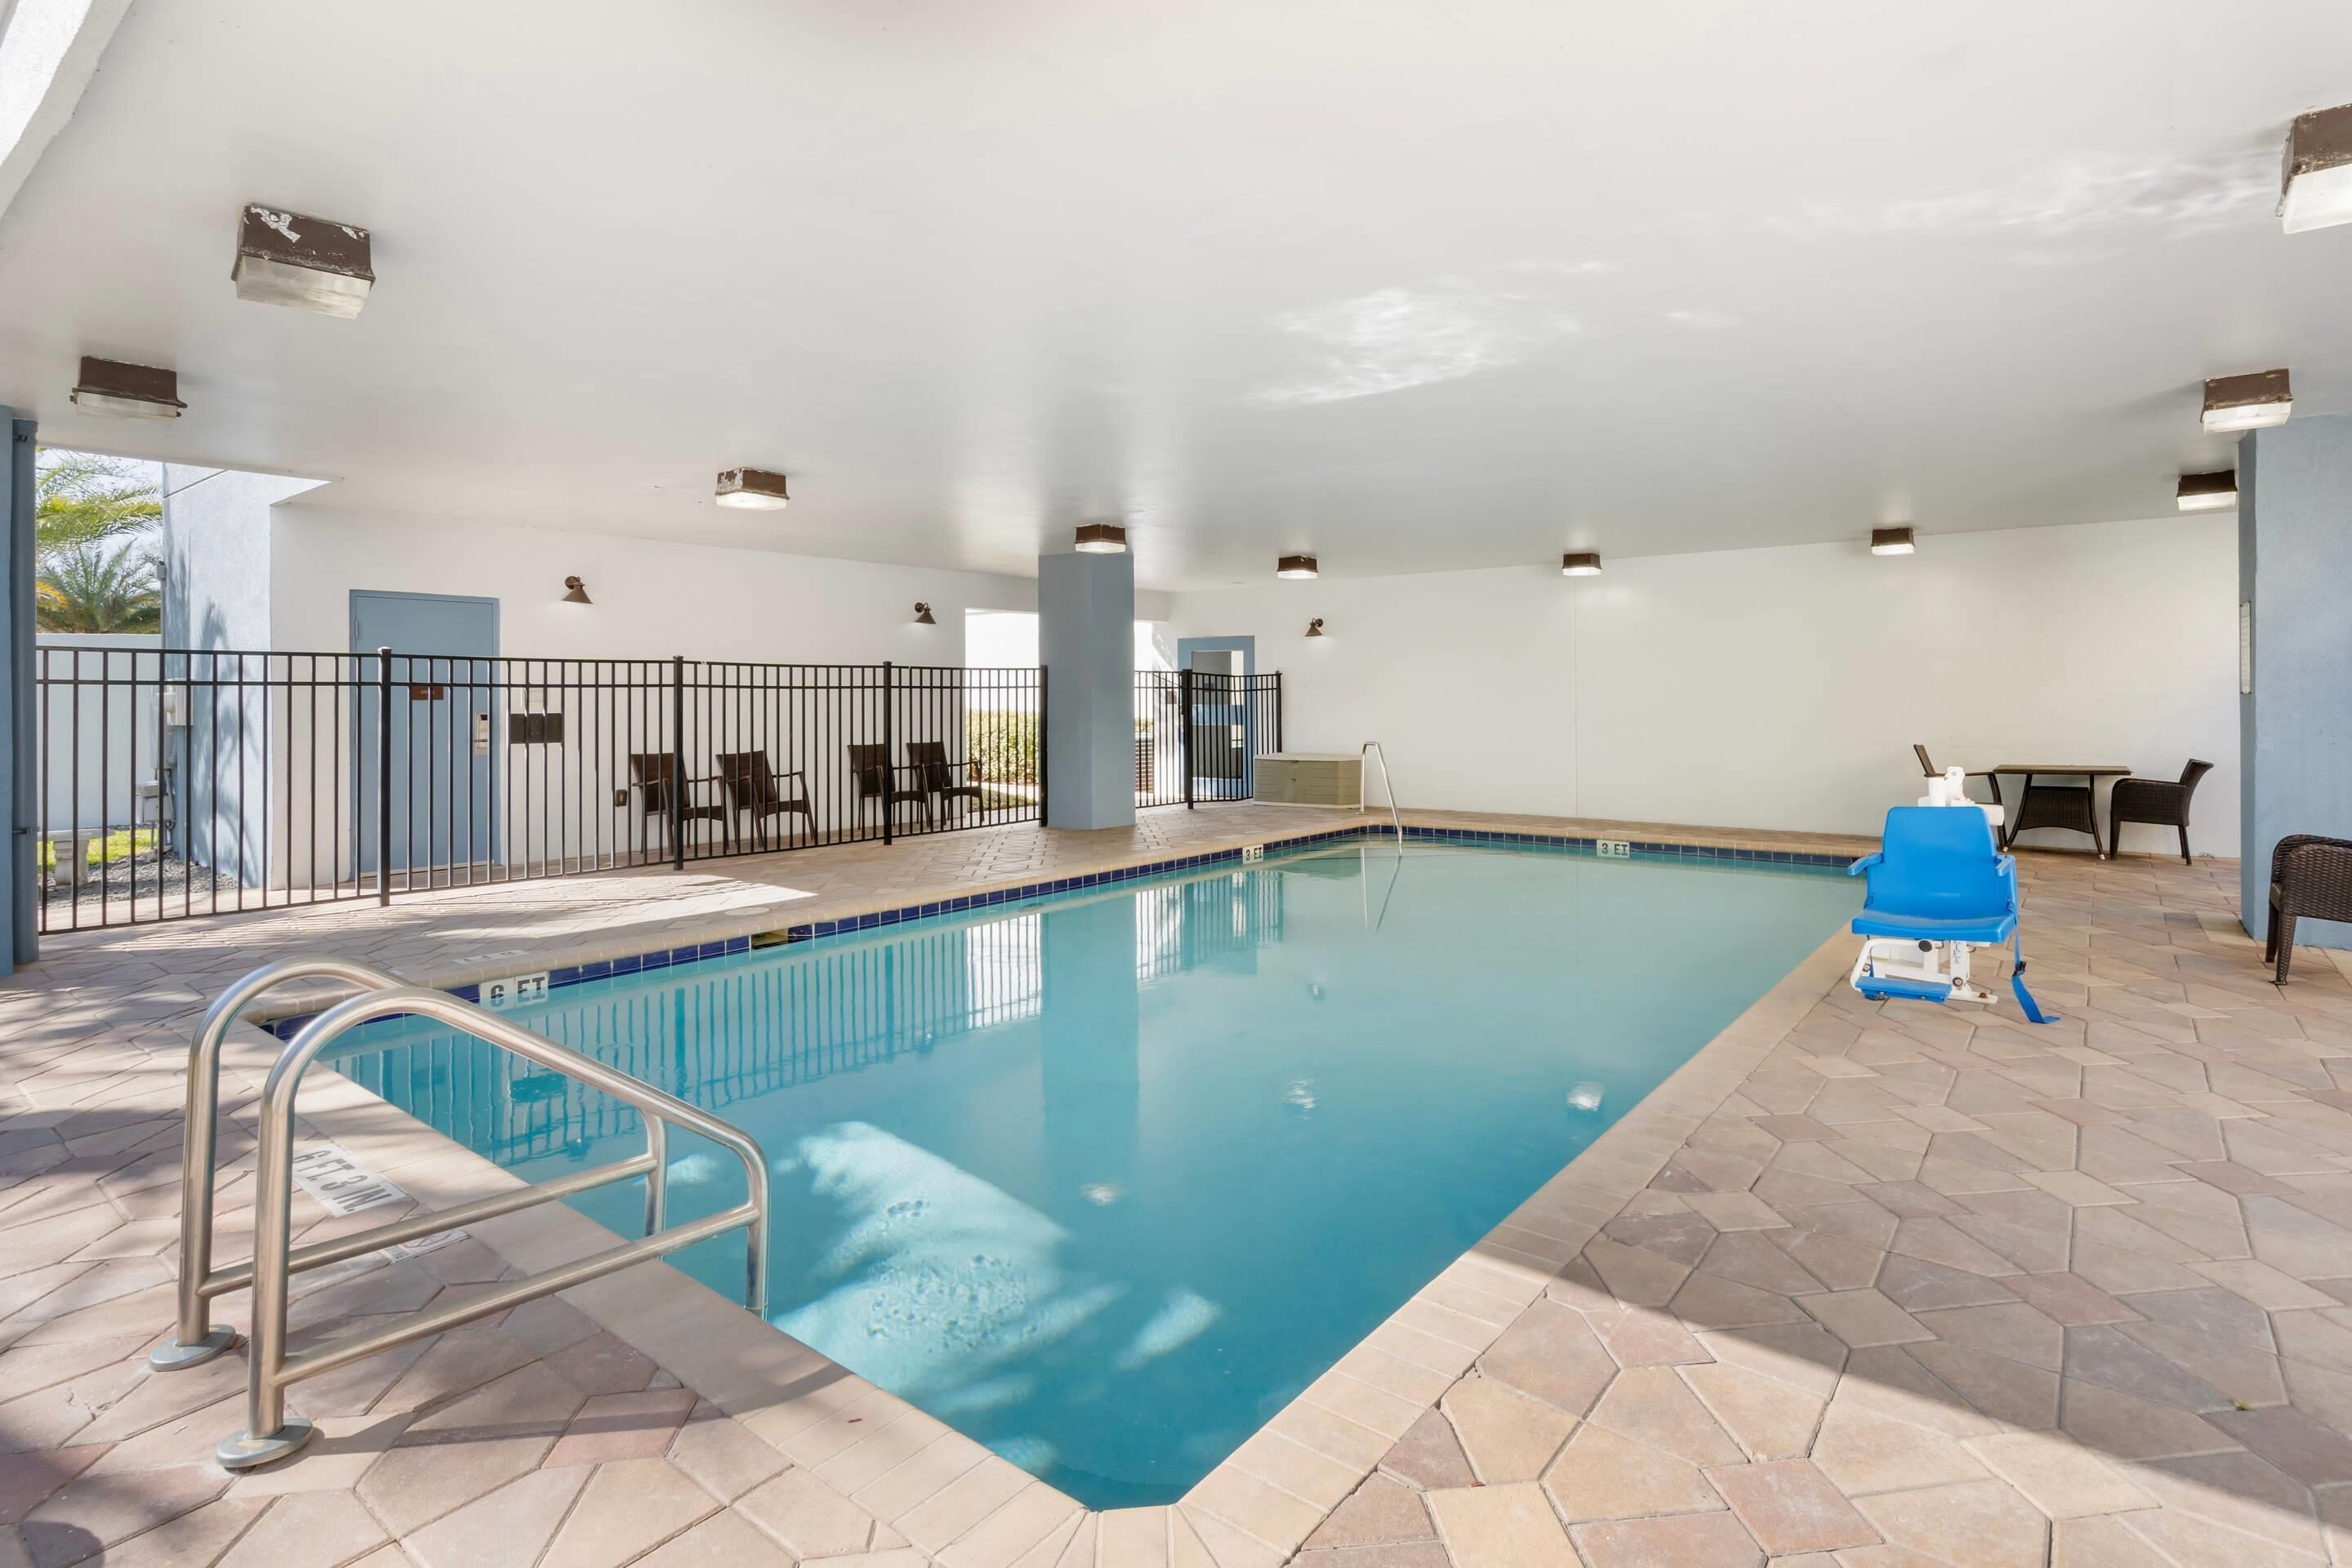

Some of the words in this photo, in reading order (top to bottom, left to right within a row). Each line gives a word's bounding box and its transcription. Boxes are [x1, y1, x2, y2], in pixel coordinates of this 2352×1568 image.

[1245, 849, 1251, 862] 3
[1601, 842, 1609, 855] 3
[490, 984, 505, 1001] 6
[292, 1150, 332, 1164] 6
[320, 1175, 368, 1191] 3
[332, 1184, 392, 1212] IN.
